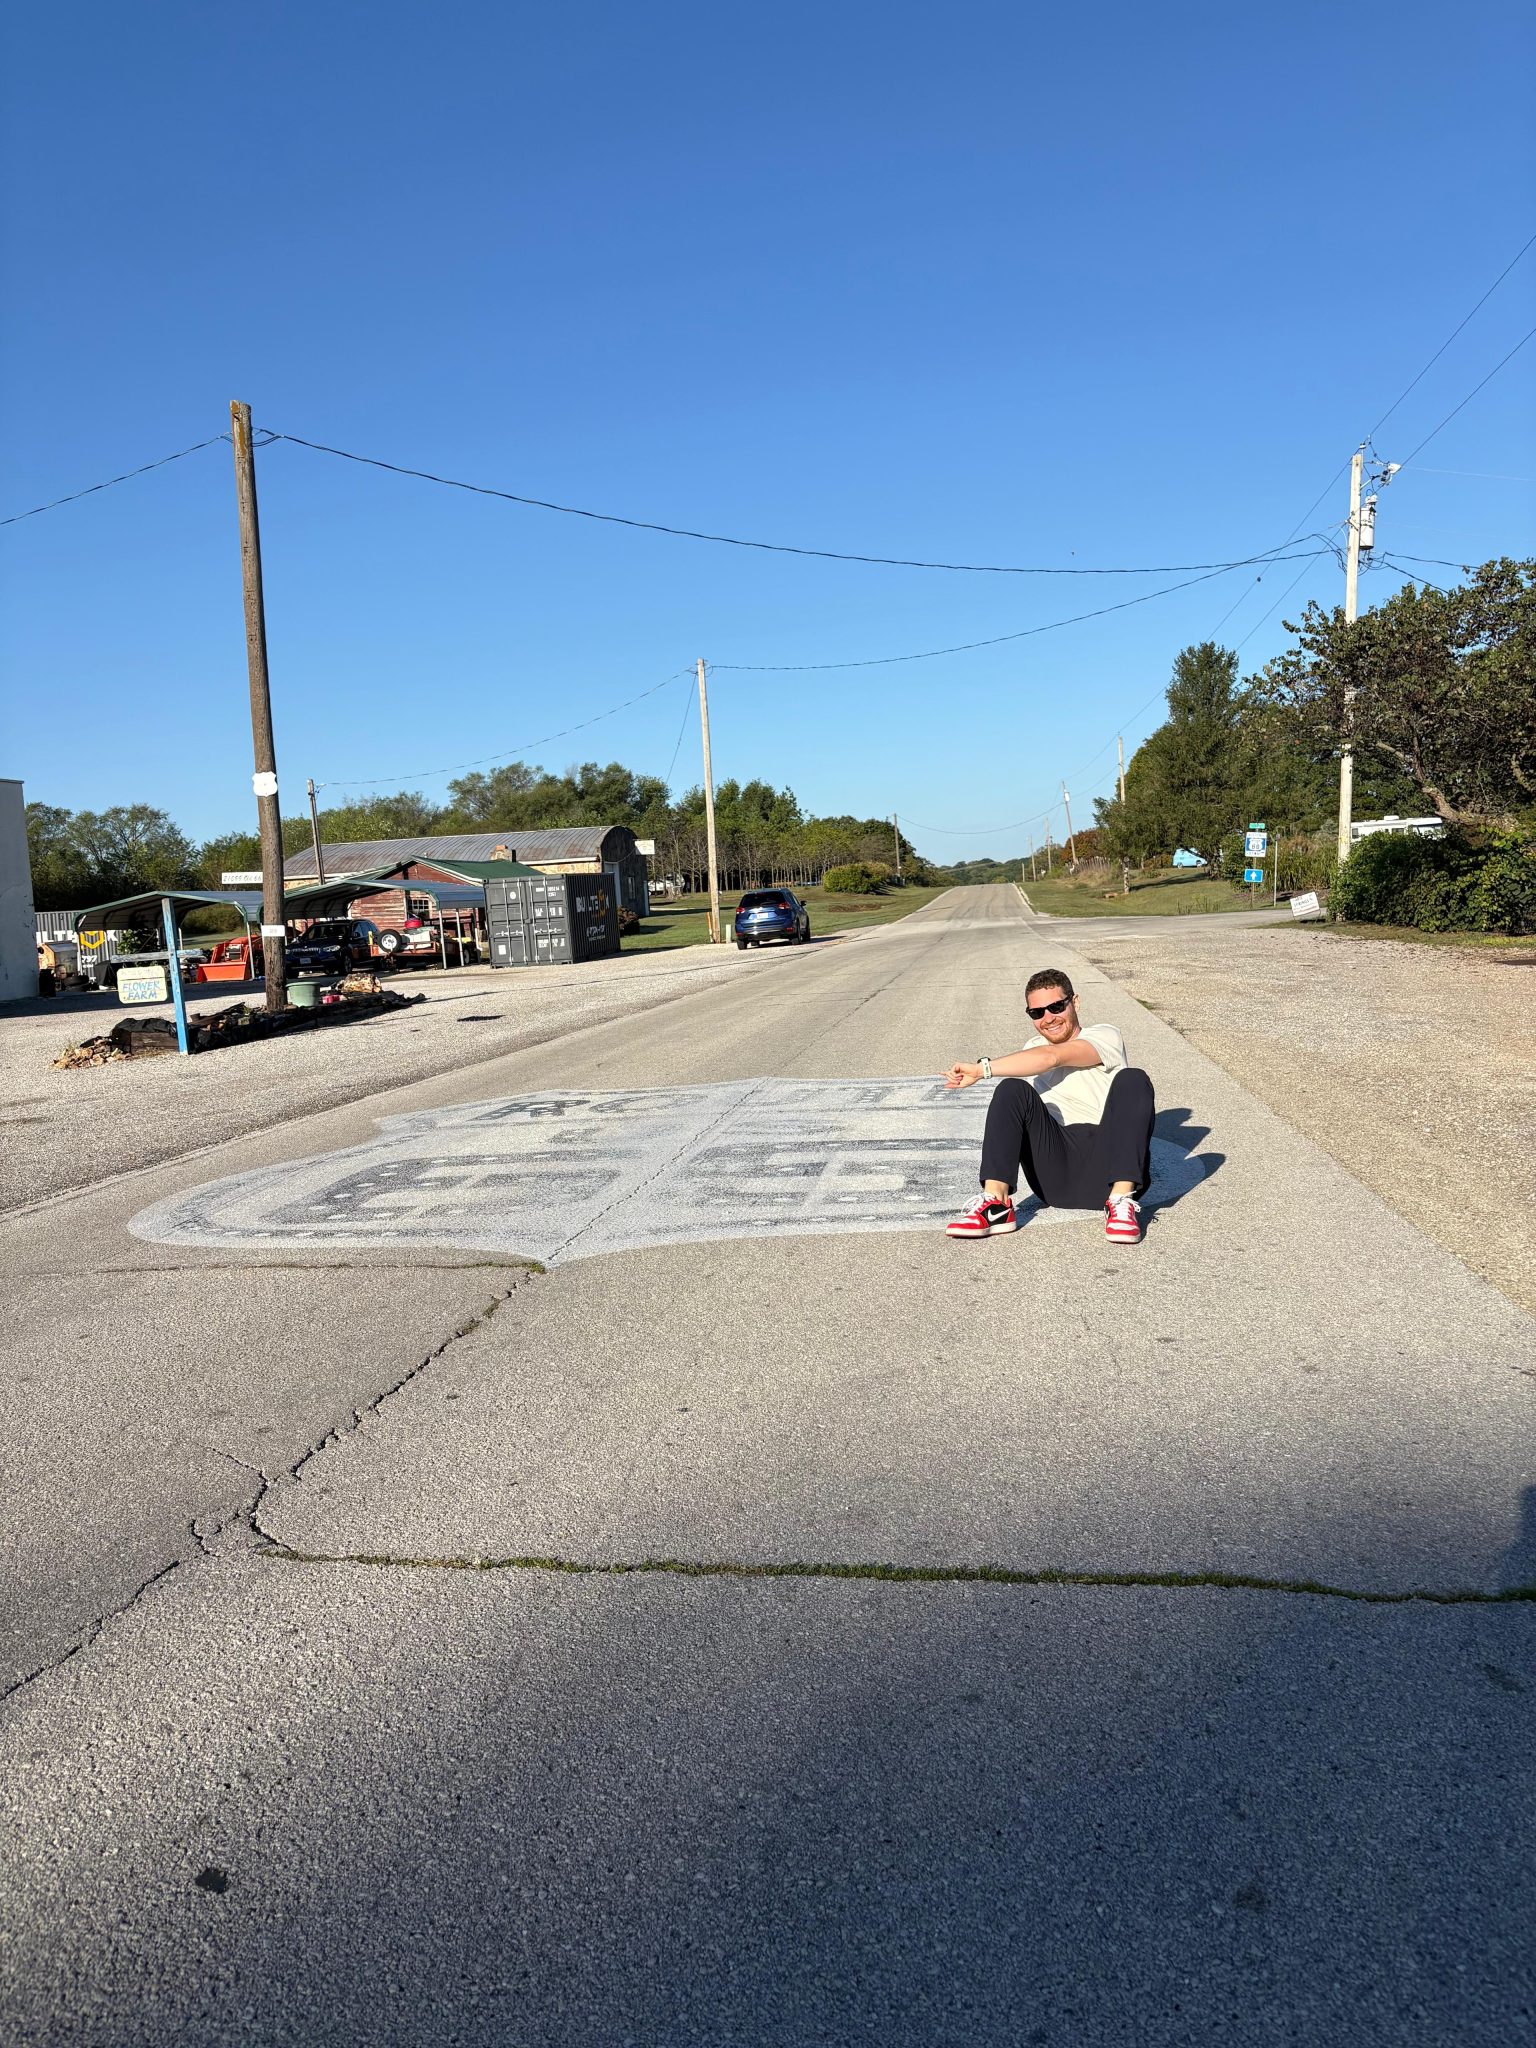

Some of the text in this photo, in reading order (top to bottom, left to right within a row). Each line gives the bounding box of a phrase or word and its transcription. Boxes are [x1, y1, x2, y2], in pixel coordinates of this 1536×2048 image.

[122, 980, 161, 992] FLOWER
[127, 990, 158, 1001] FARM
[465, 1083, 996, 1121] ROUTE
